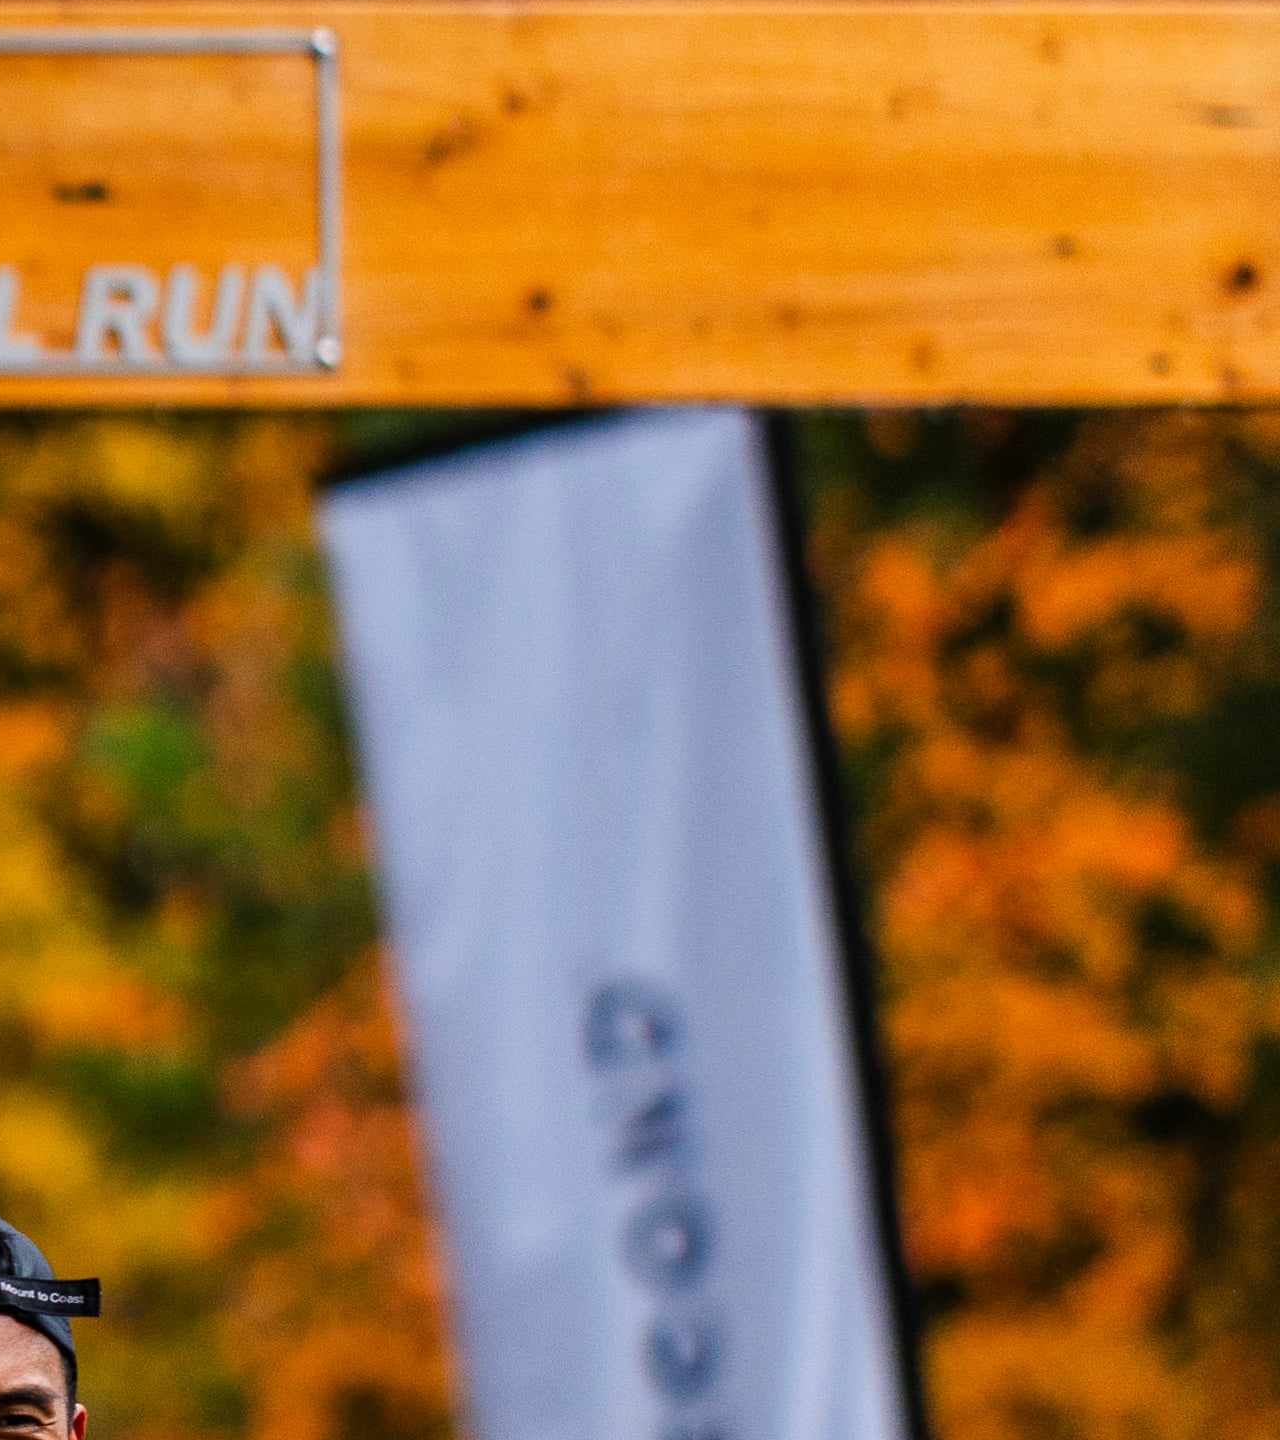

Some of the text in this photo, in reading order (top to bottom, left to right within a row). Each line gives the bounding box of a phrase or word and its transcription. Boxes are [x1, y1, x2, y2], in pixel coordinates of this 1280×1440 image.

[74, 263, 328, 366] RUN
[0, 1281, 85, 1304] Mount to Coast
